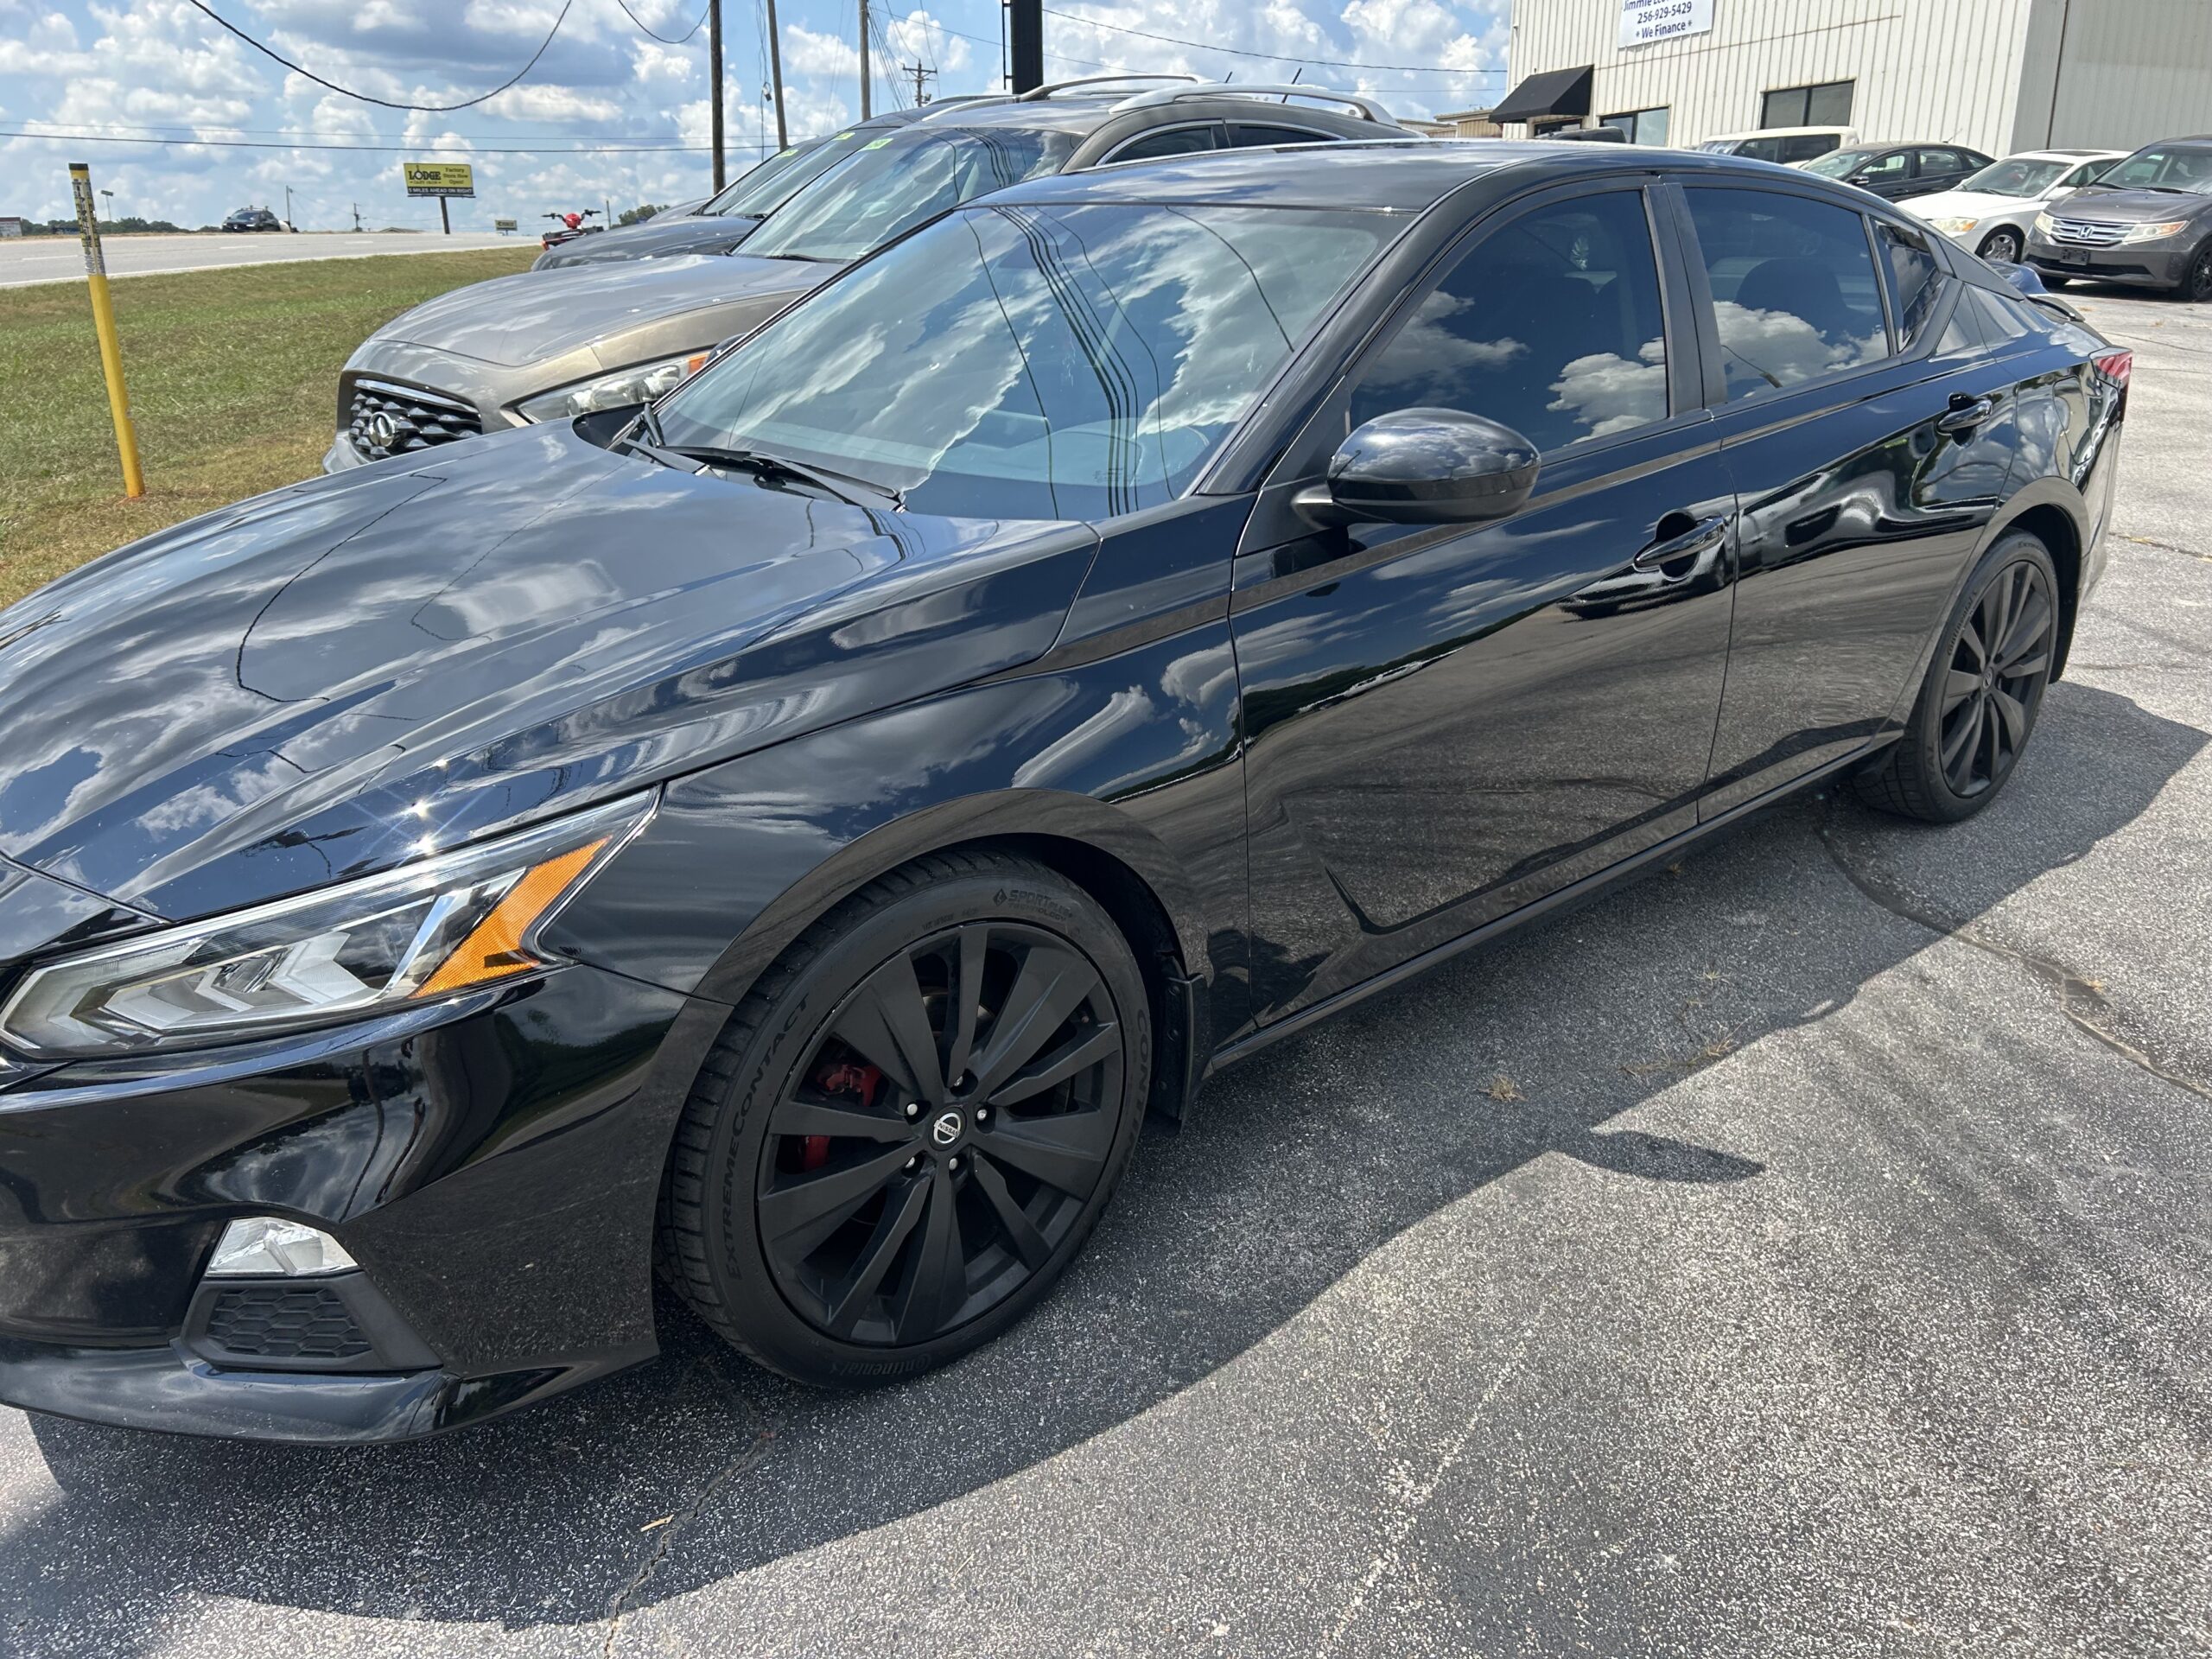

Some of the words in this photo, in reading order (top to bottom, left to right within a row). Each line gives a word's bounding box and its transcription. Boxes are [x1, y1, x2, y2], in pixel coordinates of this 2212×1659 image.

[1637, 1, 1693, 24] 256-929-5429
[1642, 27, 1653, 39] We
[1655, 22, 1686, 36] Finance
[408, 170, 442, 180] LODGE
